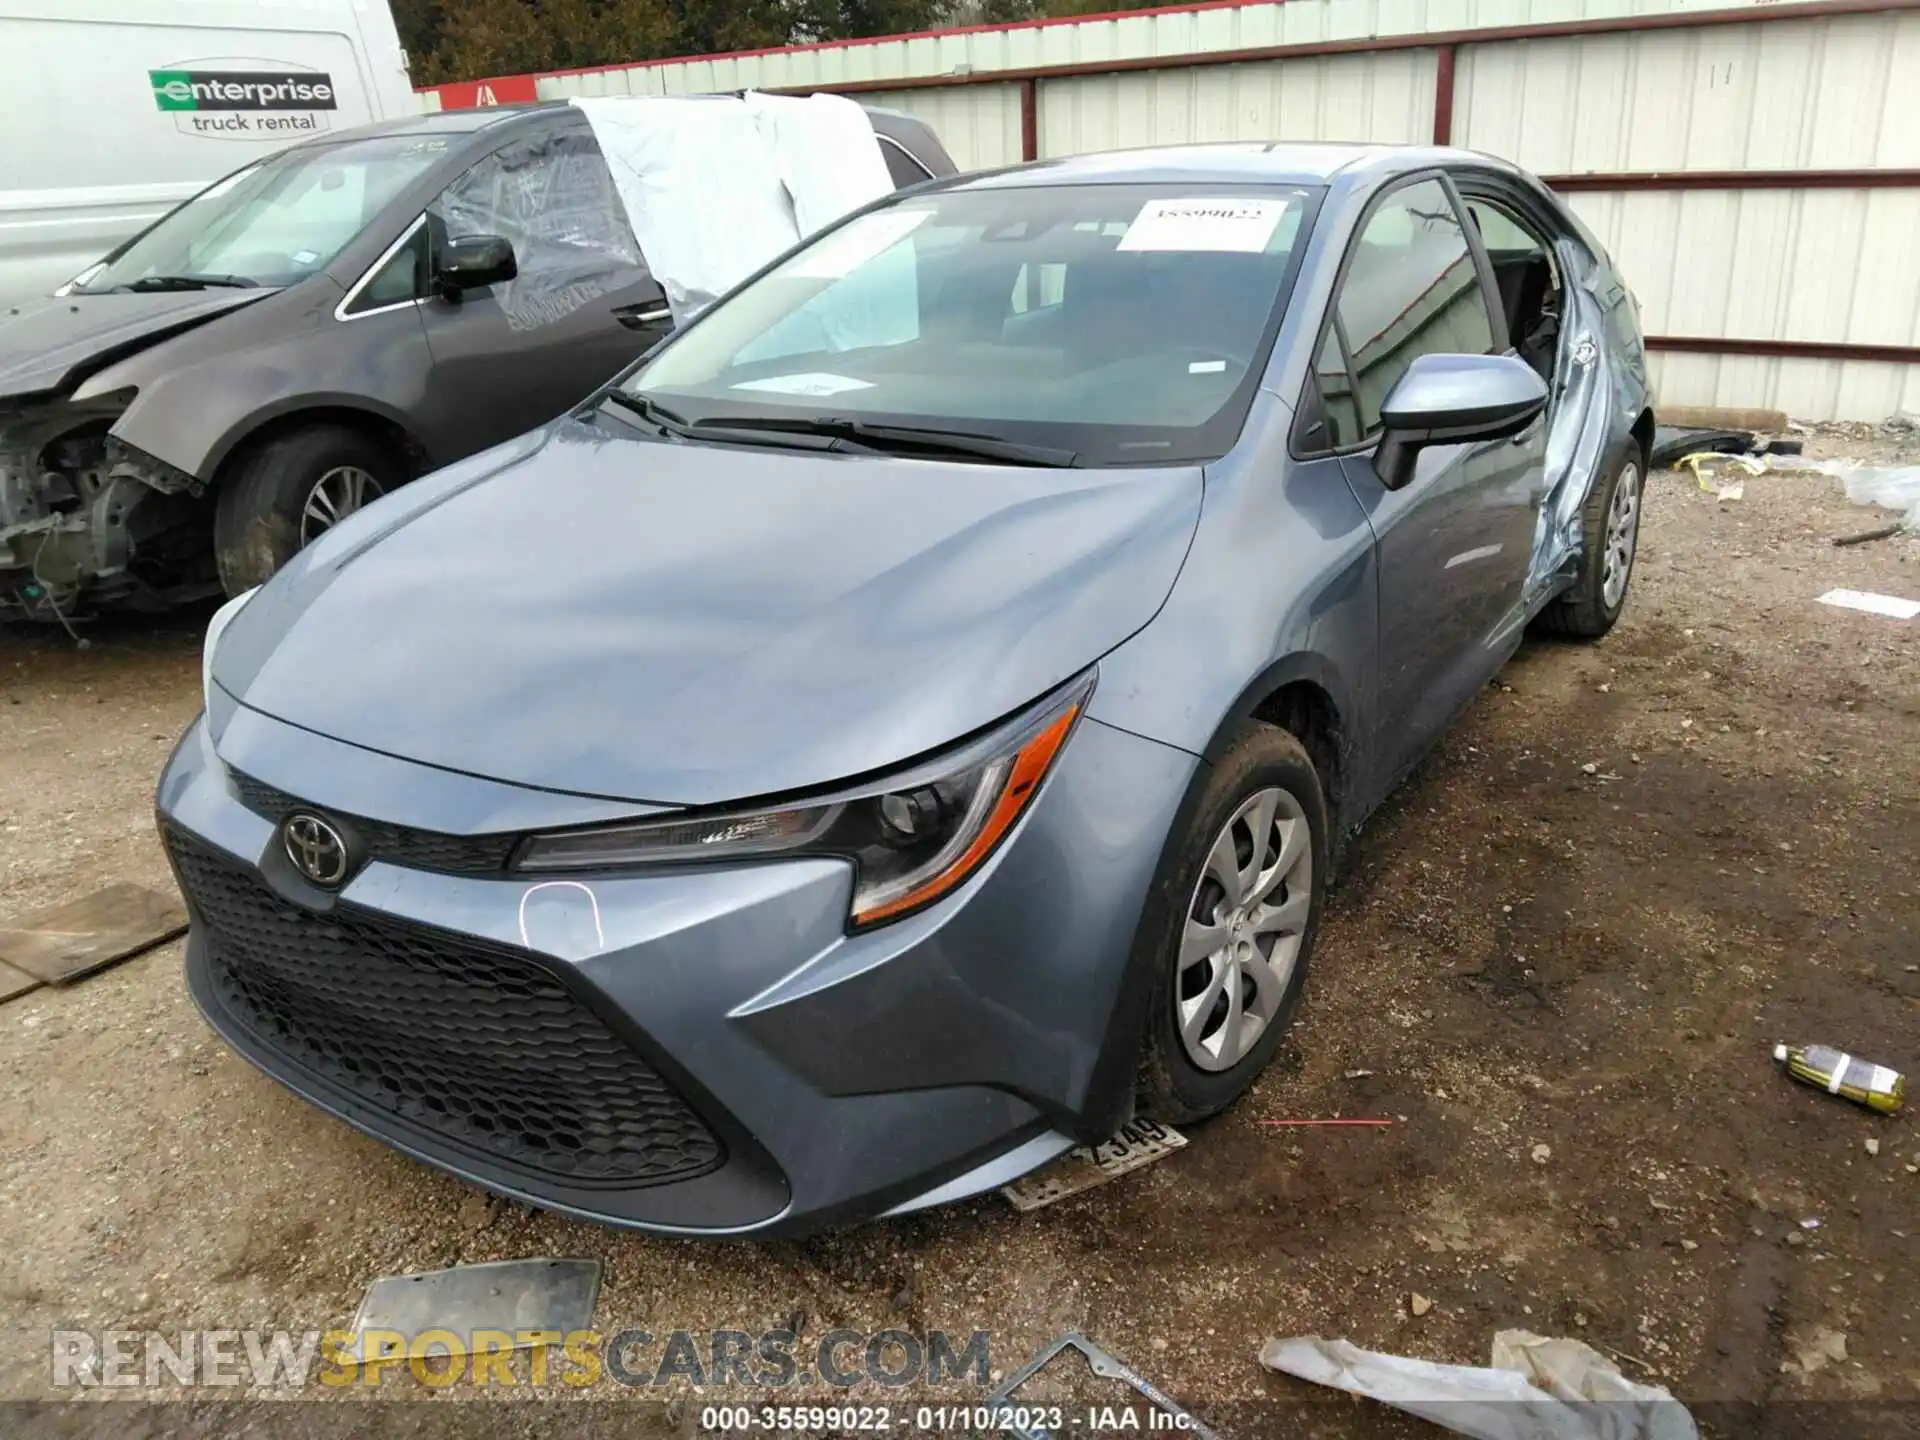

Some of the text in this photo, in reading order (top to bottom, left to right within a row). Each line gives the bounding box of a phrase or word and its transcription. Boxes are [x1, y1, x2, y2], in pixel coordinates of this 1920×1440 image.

[163, 78, 332, 106] enterprise
[192, 113, 318, 131] truck rental
